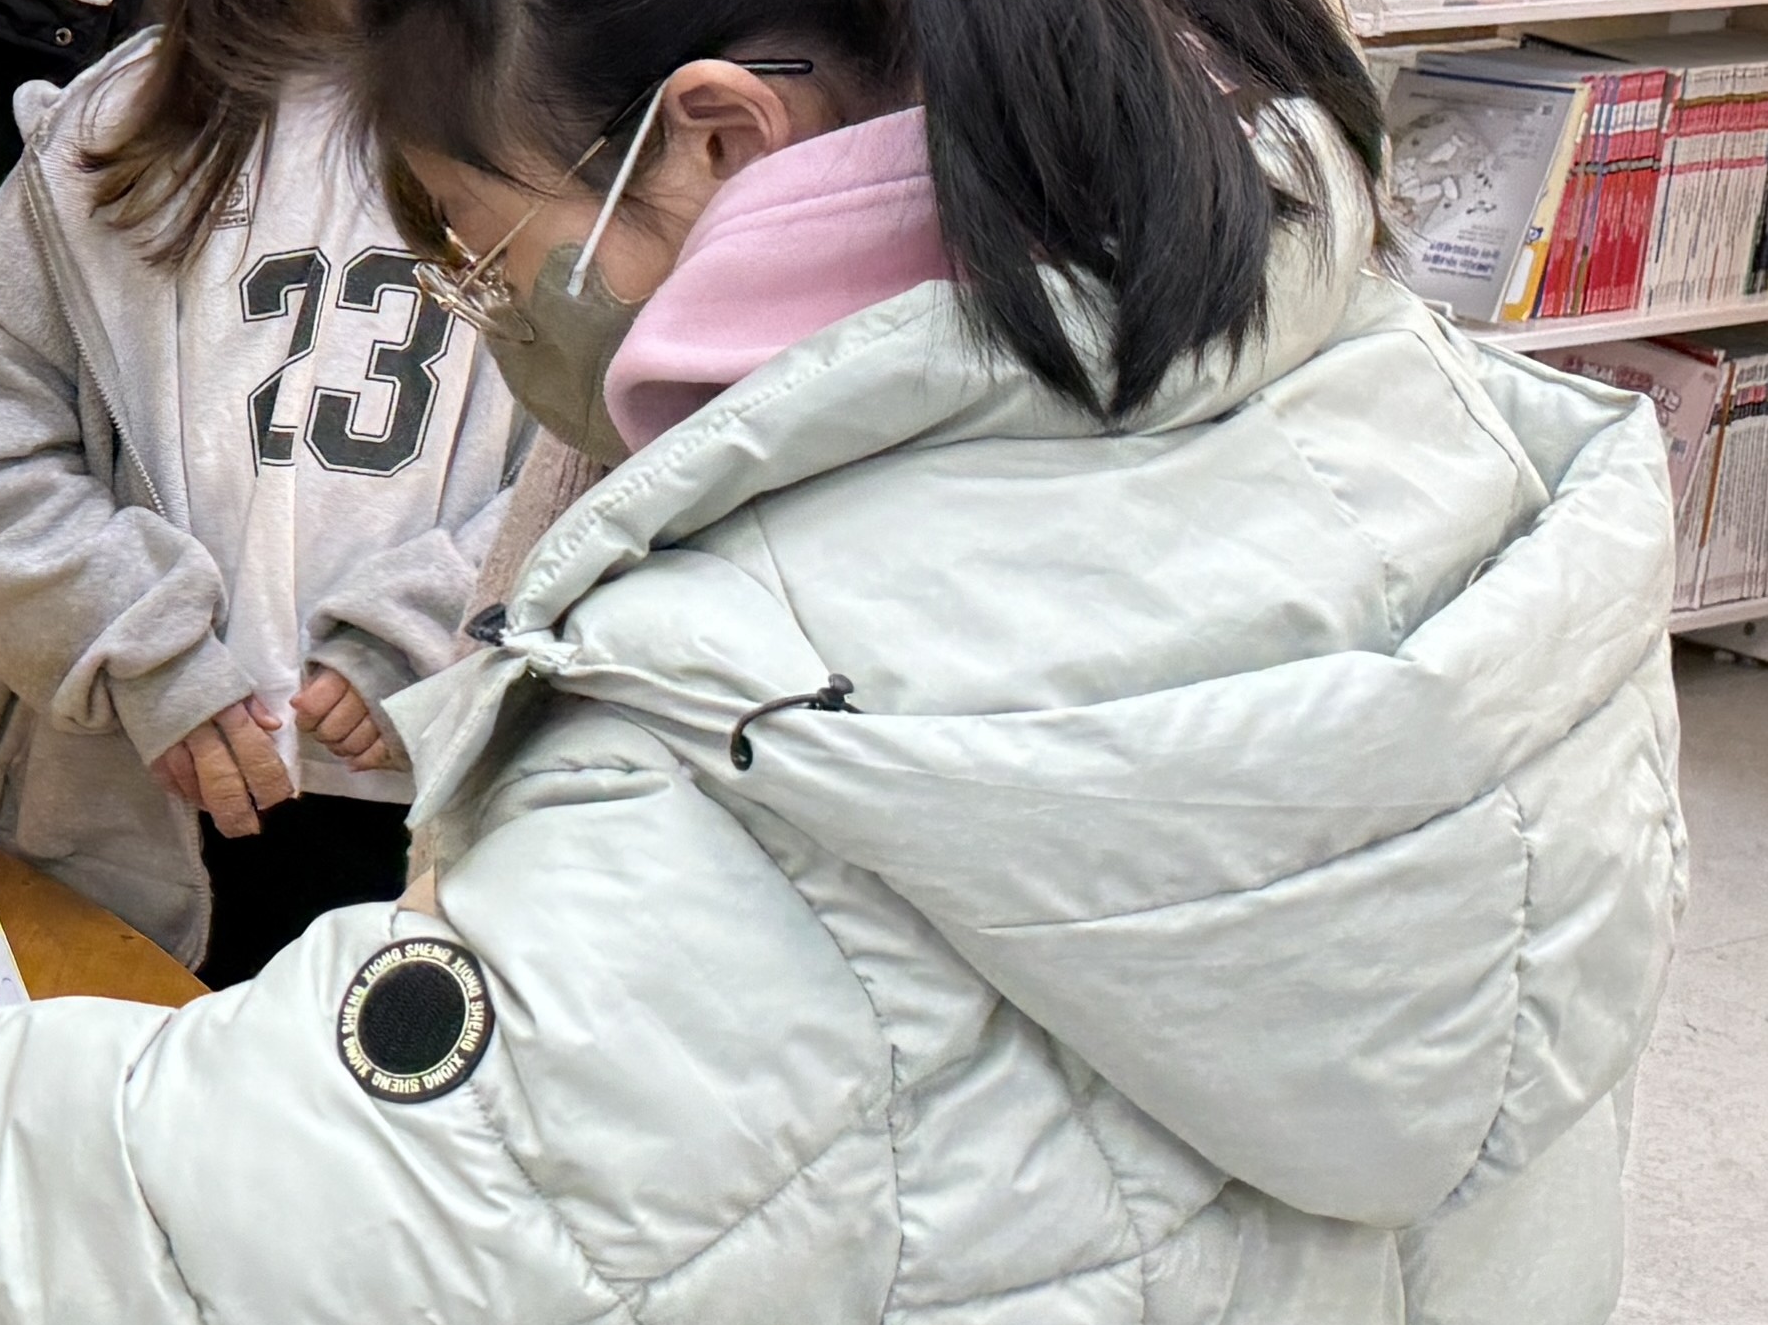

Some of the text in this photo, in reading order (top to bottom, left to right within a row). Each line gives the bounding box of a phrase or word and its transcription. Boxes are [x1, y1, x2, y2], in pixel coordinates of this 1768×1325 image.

[239, 245, 457, 478] 23
[361, 947, 403, 984] XIONG
[404, 943, 453, 962] SHENG
[451, 955, 483, 996] XIONG
[341, 984, 366, 1034] SHENG
[460, 1001, 485, 1052] SHENG
[342, 1036, 372, 1078] XIONG
[422, 1053, 465, 1090] XIONG
[371, 1072, 421, 1094] SHENG
